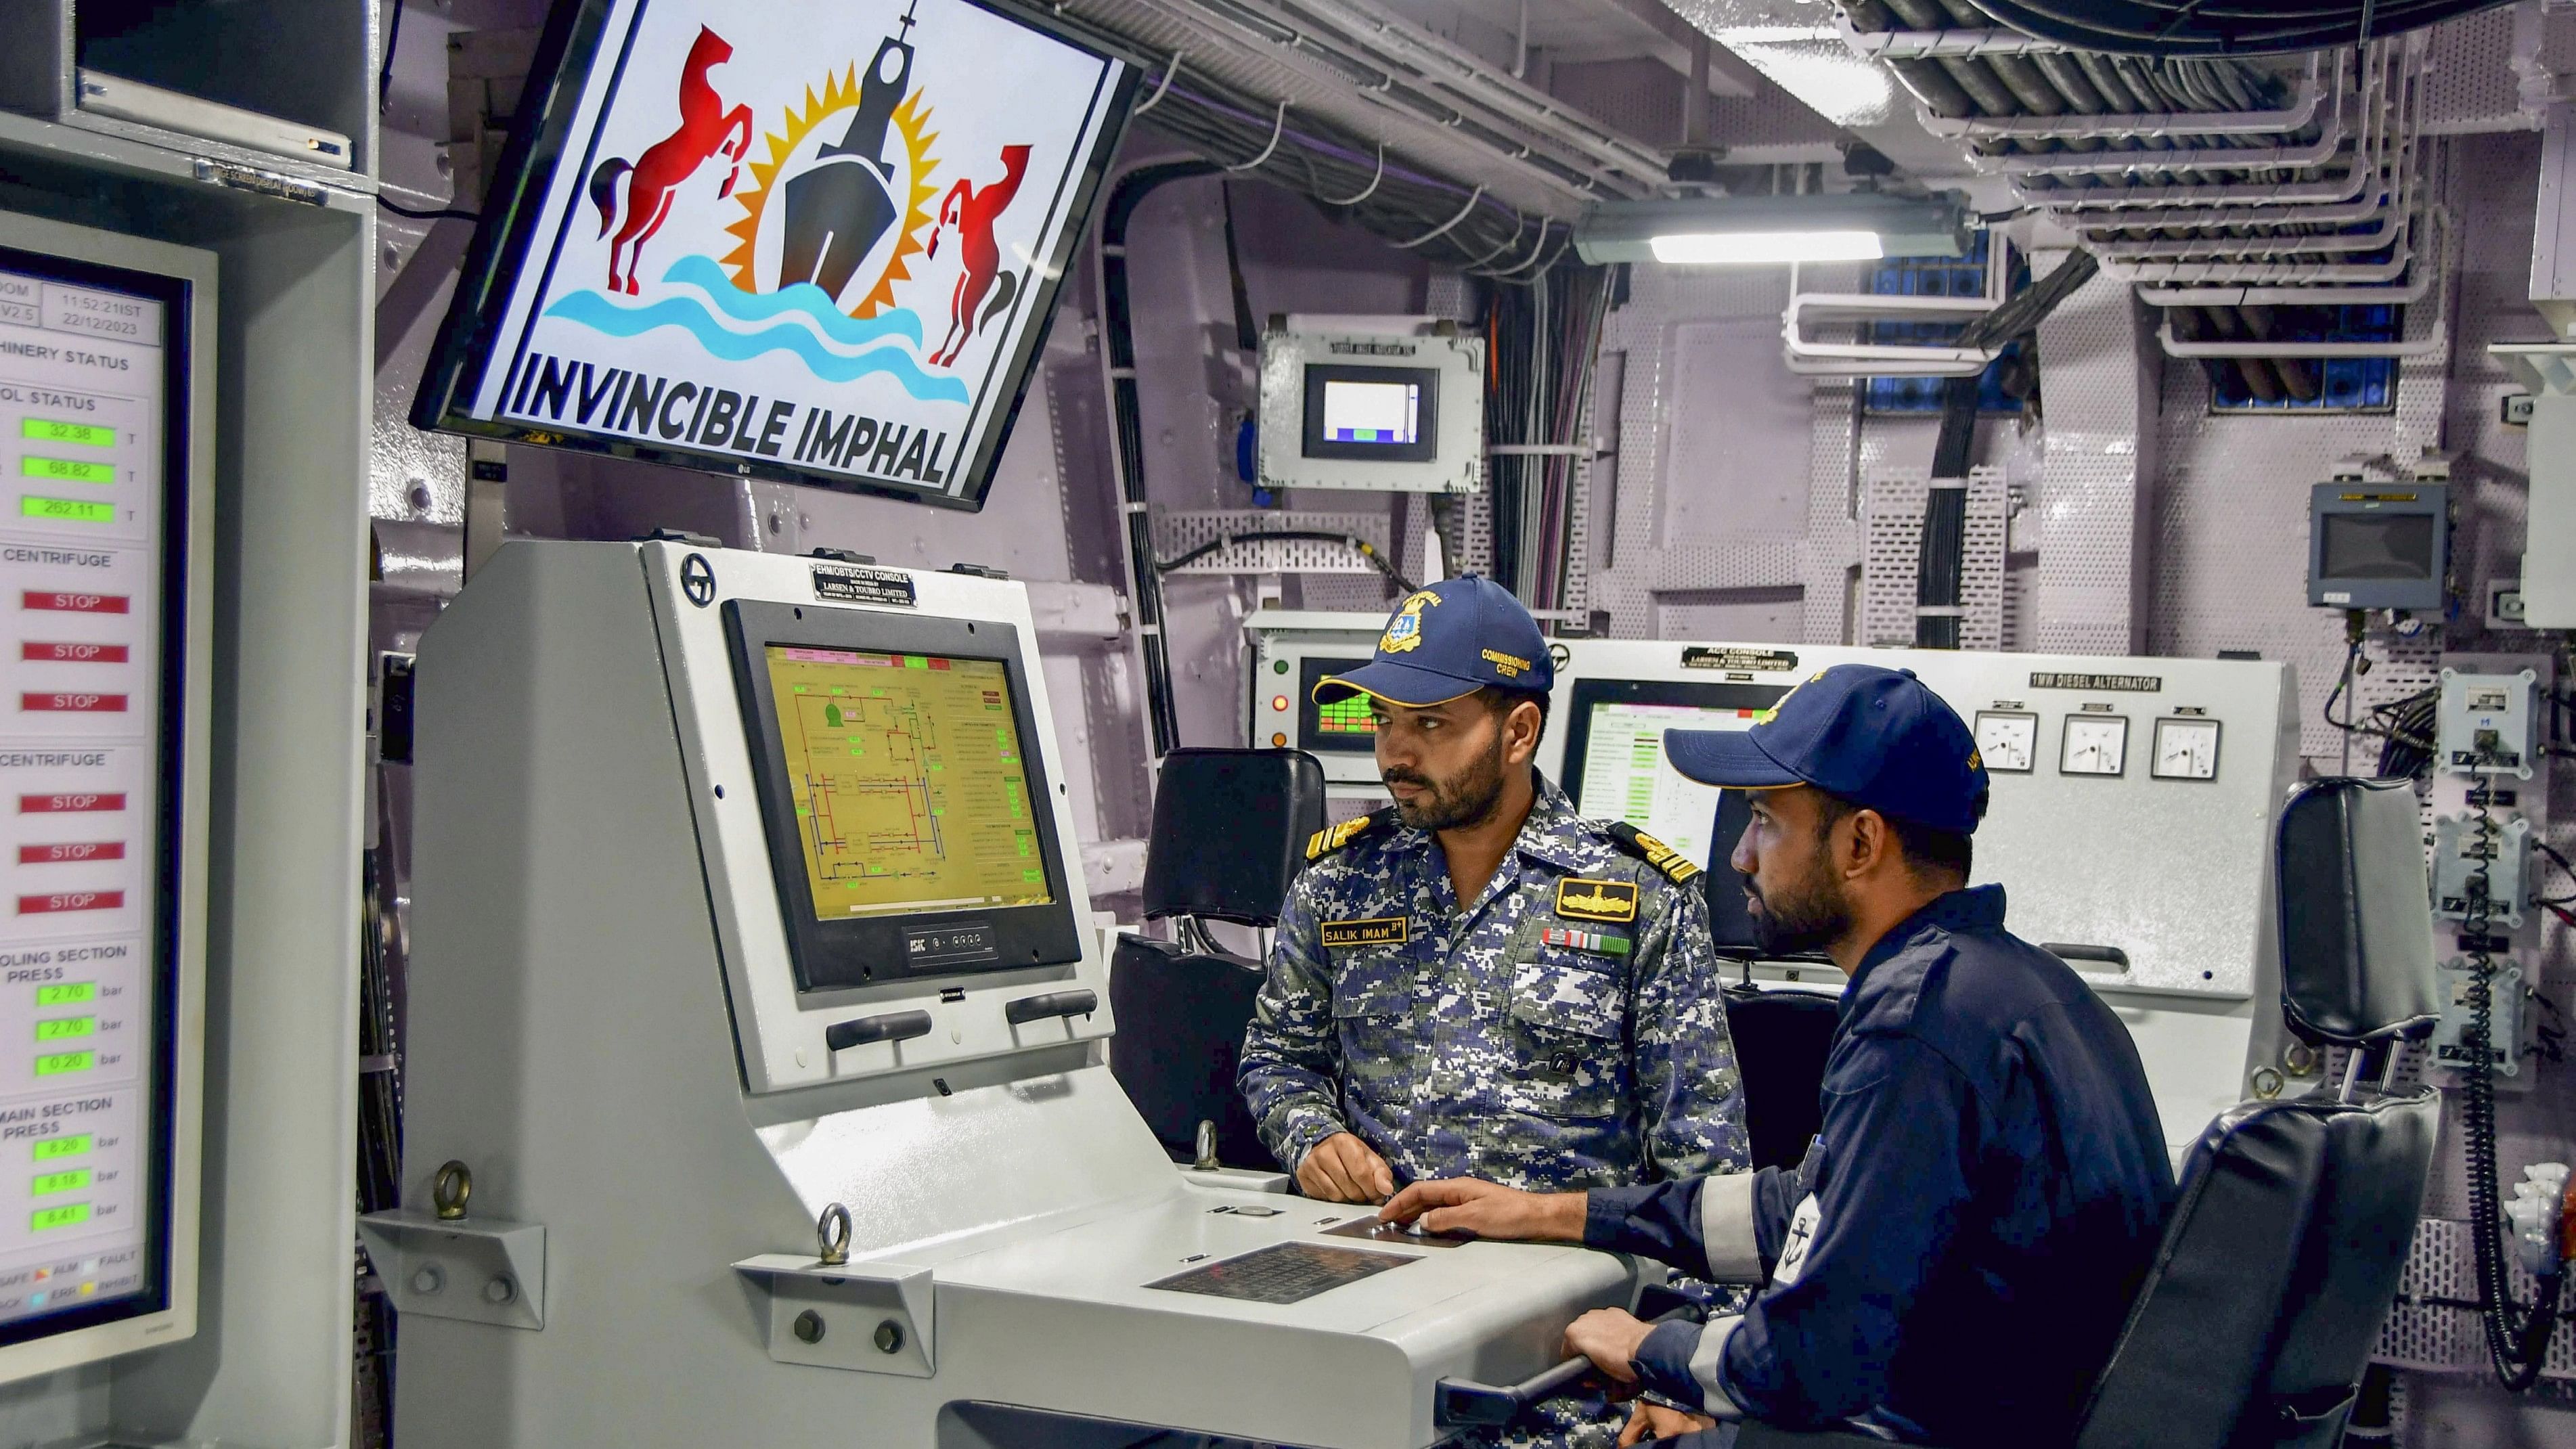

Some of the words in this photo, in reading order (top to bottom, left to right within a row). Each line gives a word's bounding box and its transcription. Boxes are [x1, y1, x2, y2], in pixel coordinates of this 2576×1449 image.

[3, 306, 33, 321] V2.5
[64, 313, 137, 335] 22/12/2023
[66, 351, 129, 371] STATUS
[30, 392, 95, 411] STATUS
[510, 353, 797, 457] INVINCIBLE
[794, 407, 948, 484] IMPHAL
[49, 424, 91, 440] 32.38
[128, 433, 135, 444] T
[49, 462, 91, 477] 68.82
[128, 471, 135, 482] T
[45, 500, 94, 516] 262.11
[127, 510, 135, 521] T
[4, 548, 111, 567] CENTRIFUGE
[816, 565, 874, 580] EHM/OBTS/CCTV
[875, 571, 909, 583] CONSOLE
[823, 582, 848, 592] LARSEN
[855, 585, 881, 596] TOUBRO
[881, 588, 908, 598] LIMITED
[54, 594, 101, 608] STOP
[54, 644, 99, 659] STOP
[1729, 648, 1775, 657] CONSOLE
[1482, 648, 1530, 671] COMMISSIONING
[1496, 663, 1517, 678] CREW
[2033, 673, 2055, 687] 1MW
[2056, 674, 2091, 688] DIESEL
[2093, 675, 2157, 691] ALTERNATOR
[54, 694, 99, 708] STOP
[0, 753, 105, 766] CENTRIFUGE
[52, 795, 97, 809] STOP
[51, 845, 96, 859] STOP
[50, 893, 95, 908] STOP
[1325, 931, 1358, 941] SALIK
[1362, 927, 1389, 939] IMAM
[1391, 921, 1402, 931] B+
[58, 946, 127, 963] SECTION
[7, 967, 64, 983] PRESS
[102, 985, 123, 997] bar
[101, 1019, 123, 1031] bar
[100, 1053, 120, 1065] bar
[42, 1097, 112, 1117] SECTION
[3, 1121, 60, 1140] PRESS
[98, 1137, 119, 1148] bar
[97, 1170, 119, 1182] bar
[97, 1204, 118, 1216] bar
[99, 1251, 135, 1266] FAULT
